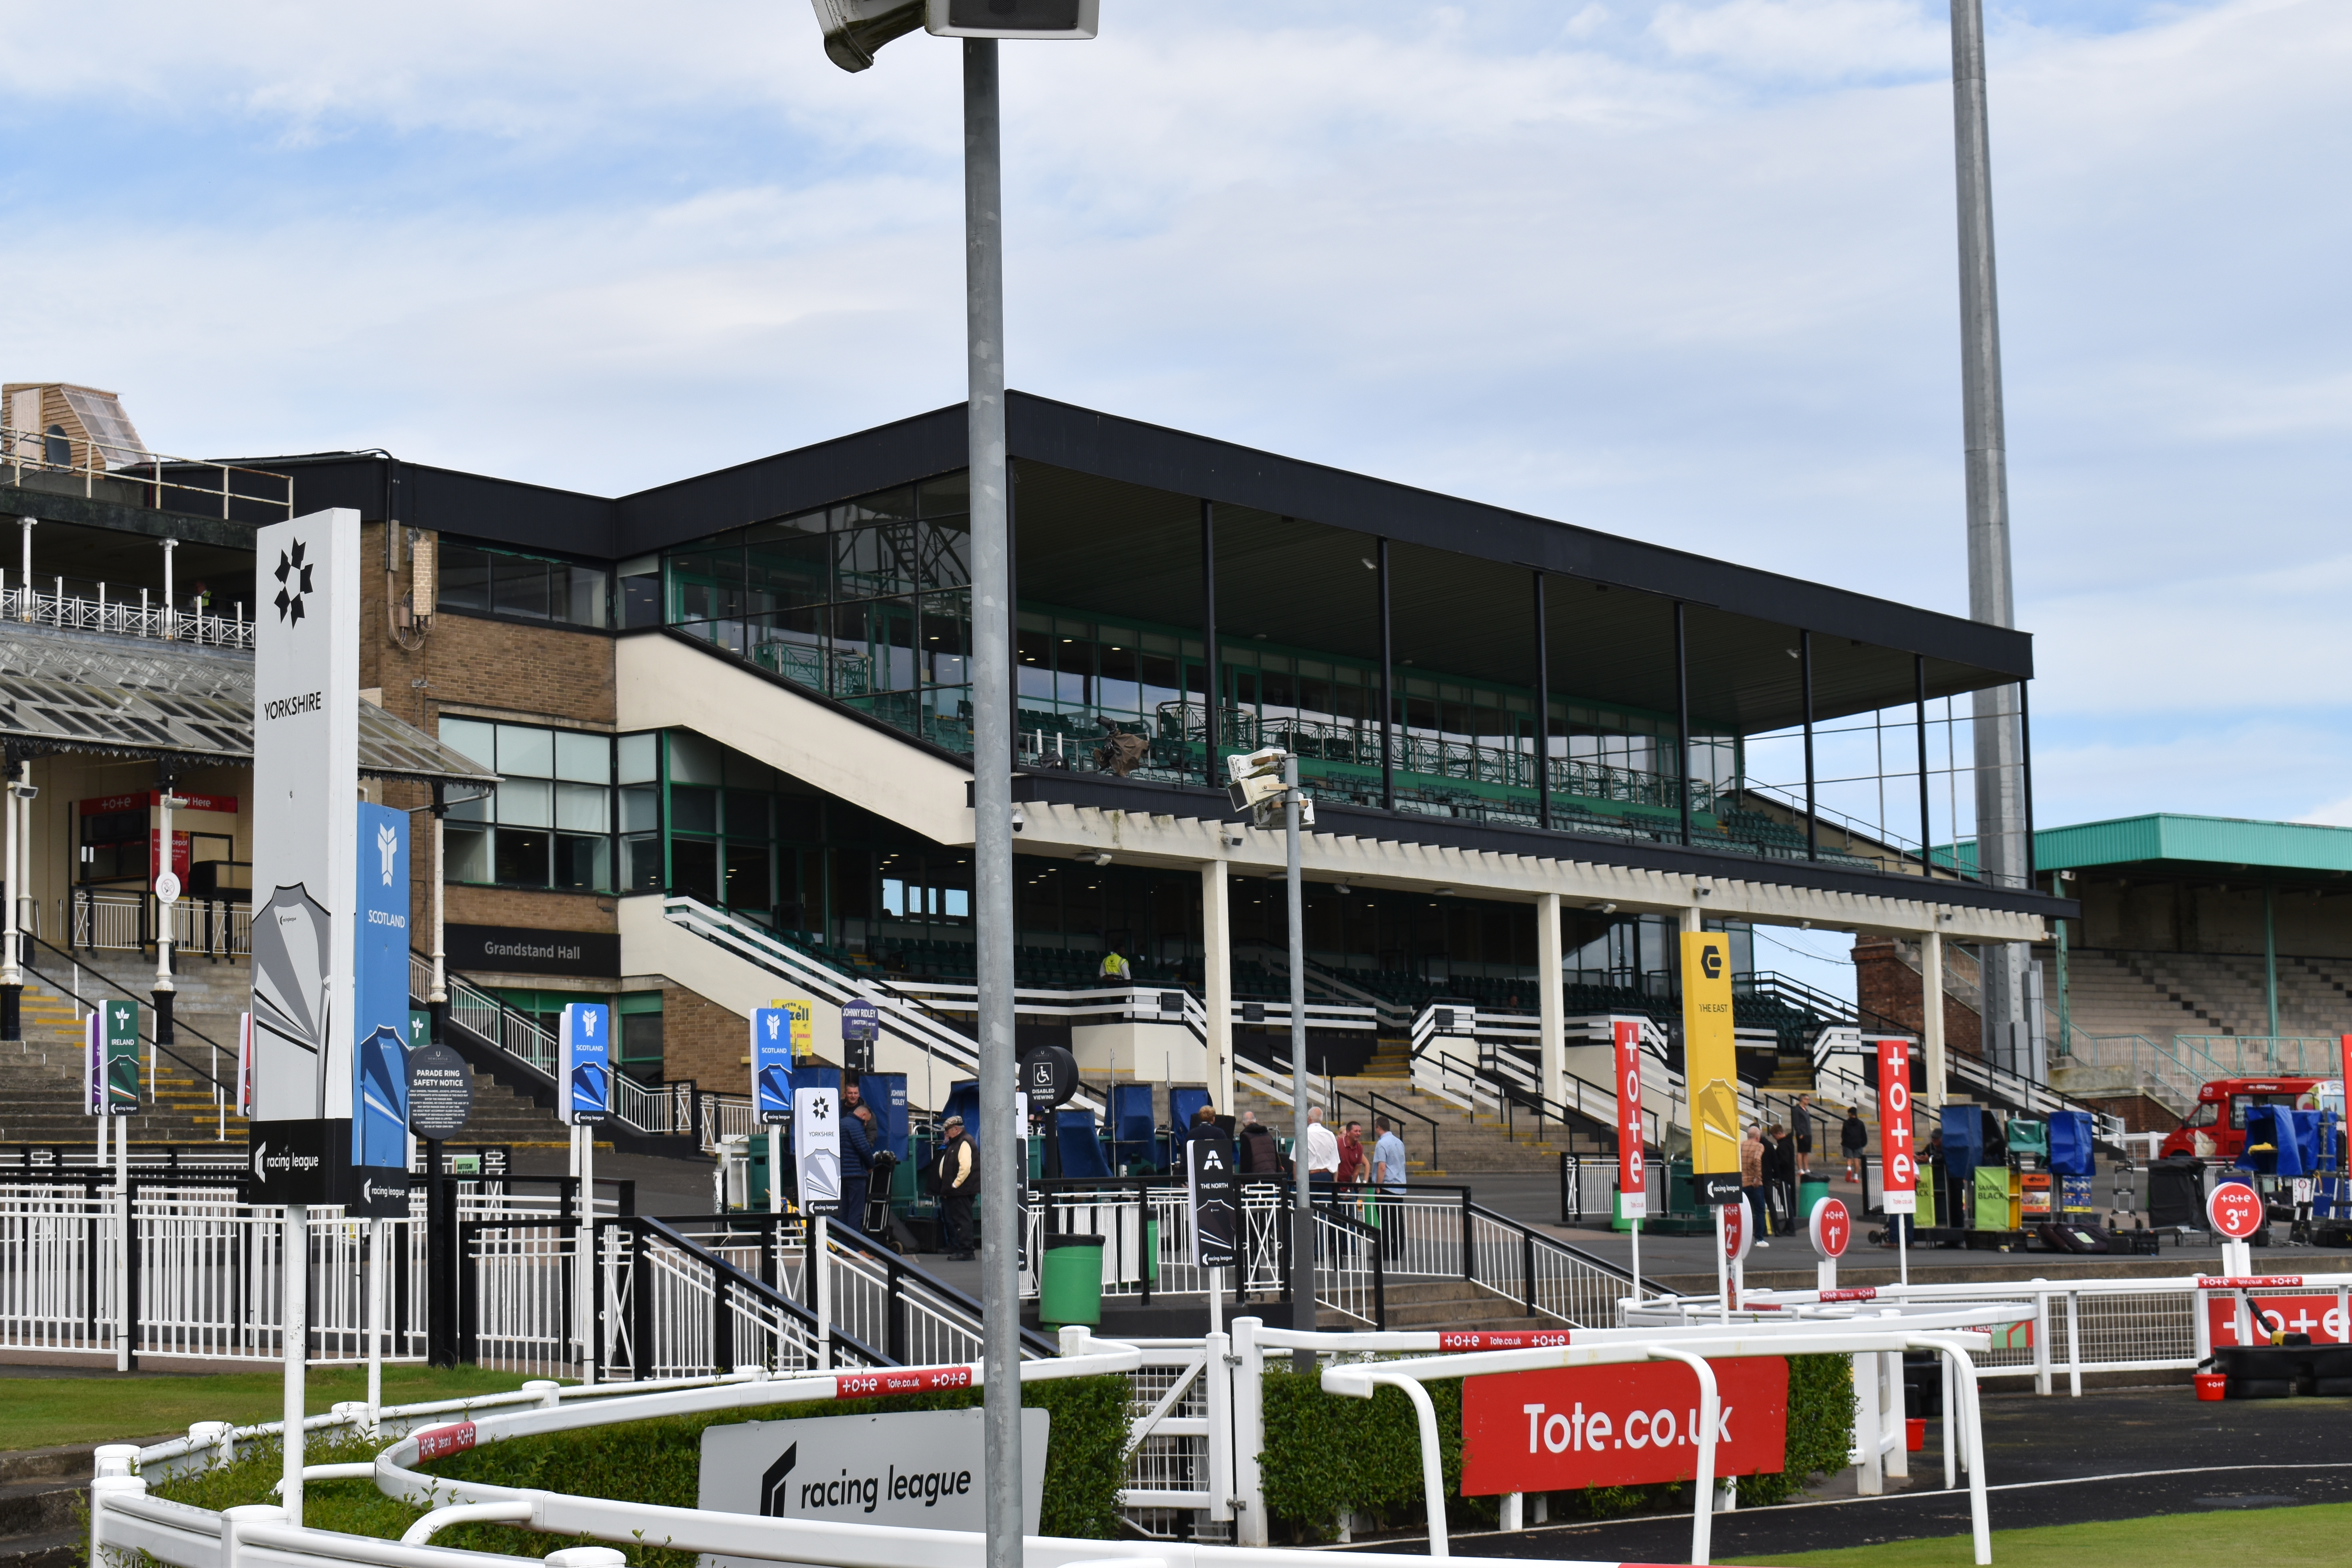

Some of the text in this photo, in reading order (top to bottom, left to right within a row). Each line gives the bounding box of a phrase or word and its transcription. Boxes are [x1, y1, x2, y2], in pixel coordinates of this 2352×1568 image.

[264, 691, 321, 721] YORKSHIRE
[192, 797, 211, 807] Here
[368, 909, 405, 928] SCOTLAND
[485, 941, 580, 959] Grandstand Hall
[843, 1008, 876, 1018] JOHNNY RIDLEY
[1713, 1004, 1728, 1012] EAST
[267, 1152, 319, 1171] racing league
[371, 1185, 405, 1198] racing league
[1490, 1336, 1521, 1345] Tote.co.uk
[887, 1377, 920, 1388] Tote.co.uk
[1523, 1396, 1733, 1453] Tote.co.uk
[801, 1464, 971, 1513] racing league
